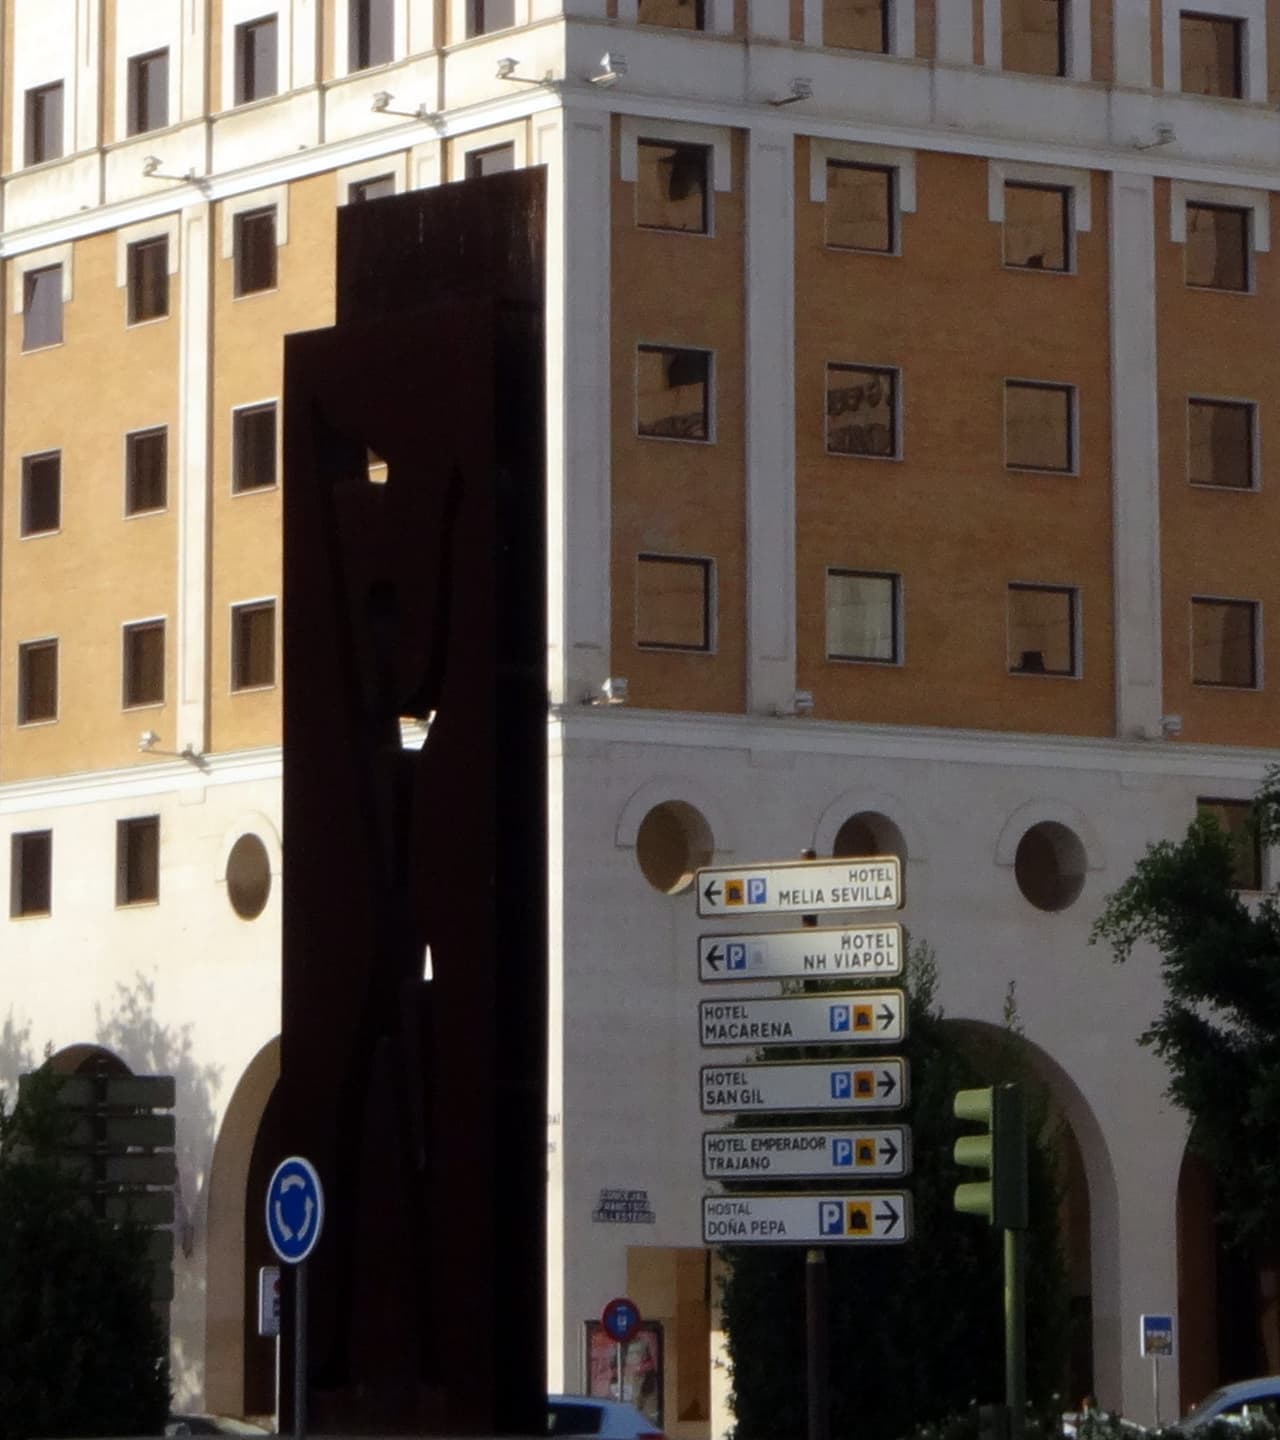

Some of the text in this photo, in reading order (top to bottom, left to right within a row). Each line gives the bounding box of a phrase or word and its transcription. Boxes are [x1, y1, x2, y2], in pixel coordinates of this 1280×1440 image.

[848, 868, 893, 883] HOTEL
[778, 885, 893, 906] MELIA SEVILLA
[841, 933, 894, 950] HOTEL
[804, 951, 895, 970] NH VIAPOL
[704, 1006, 749, 1020] HOTEL
[705, 1022, 793, 1039] MACARENA
[705, 1072, 748, 1086] HOTEL
[705, 1089, 764, 1105] SAN GIL
[707, 1136, 827, 1152] HOTEL EMPERADOR
[709, 1156, 771, 1170] TRAJANO
[707, 1203, 752, 1216] HOSTAL
[707, 1218, 787, 1236] DOÑA PEPA
